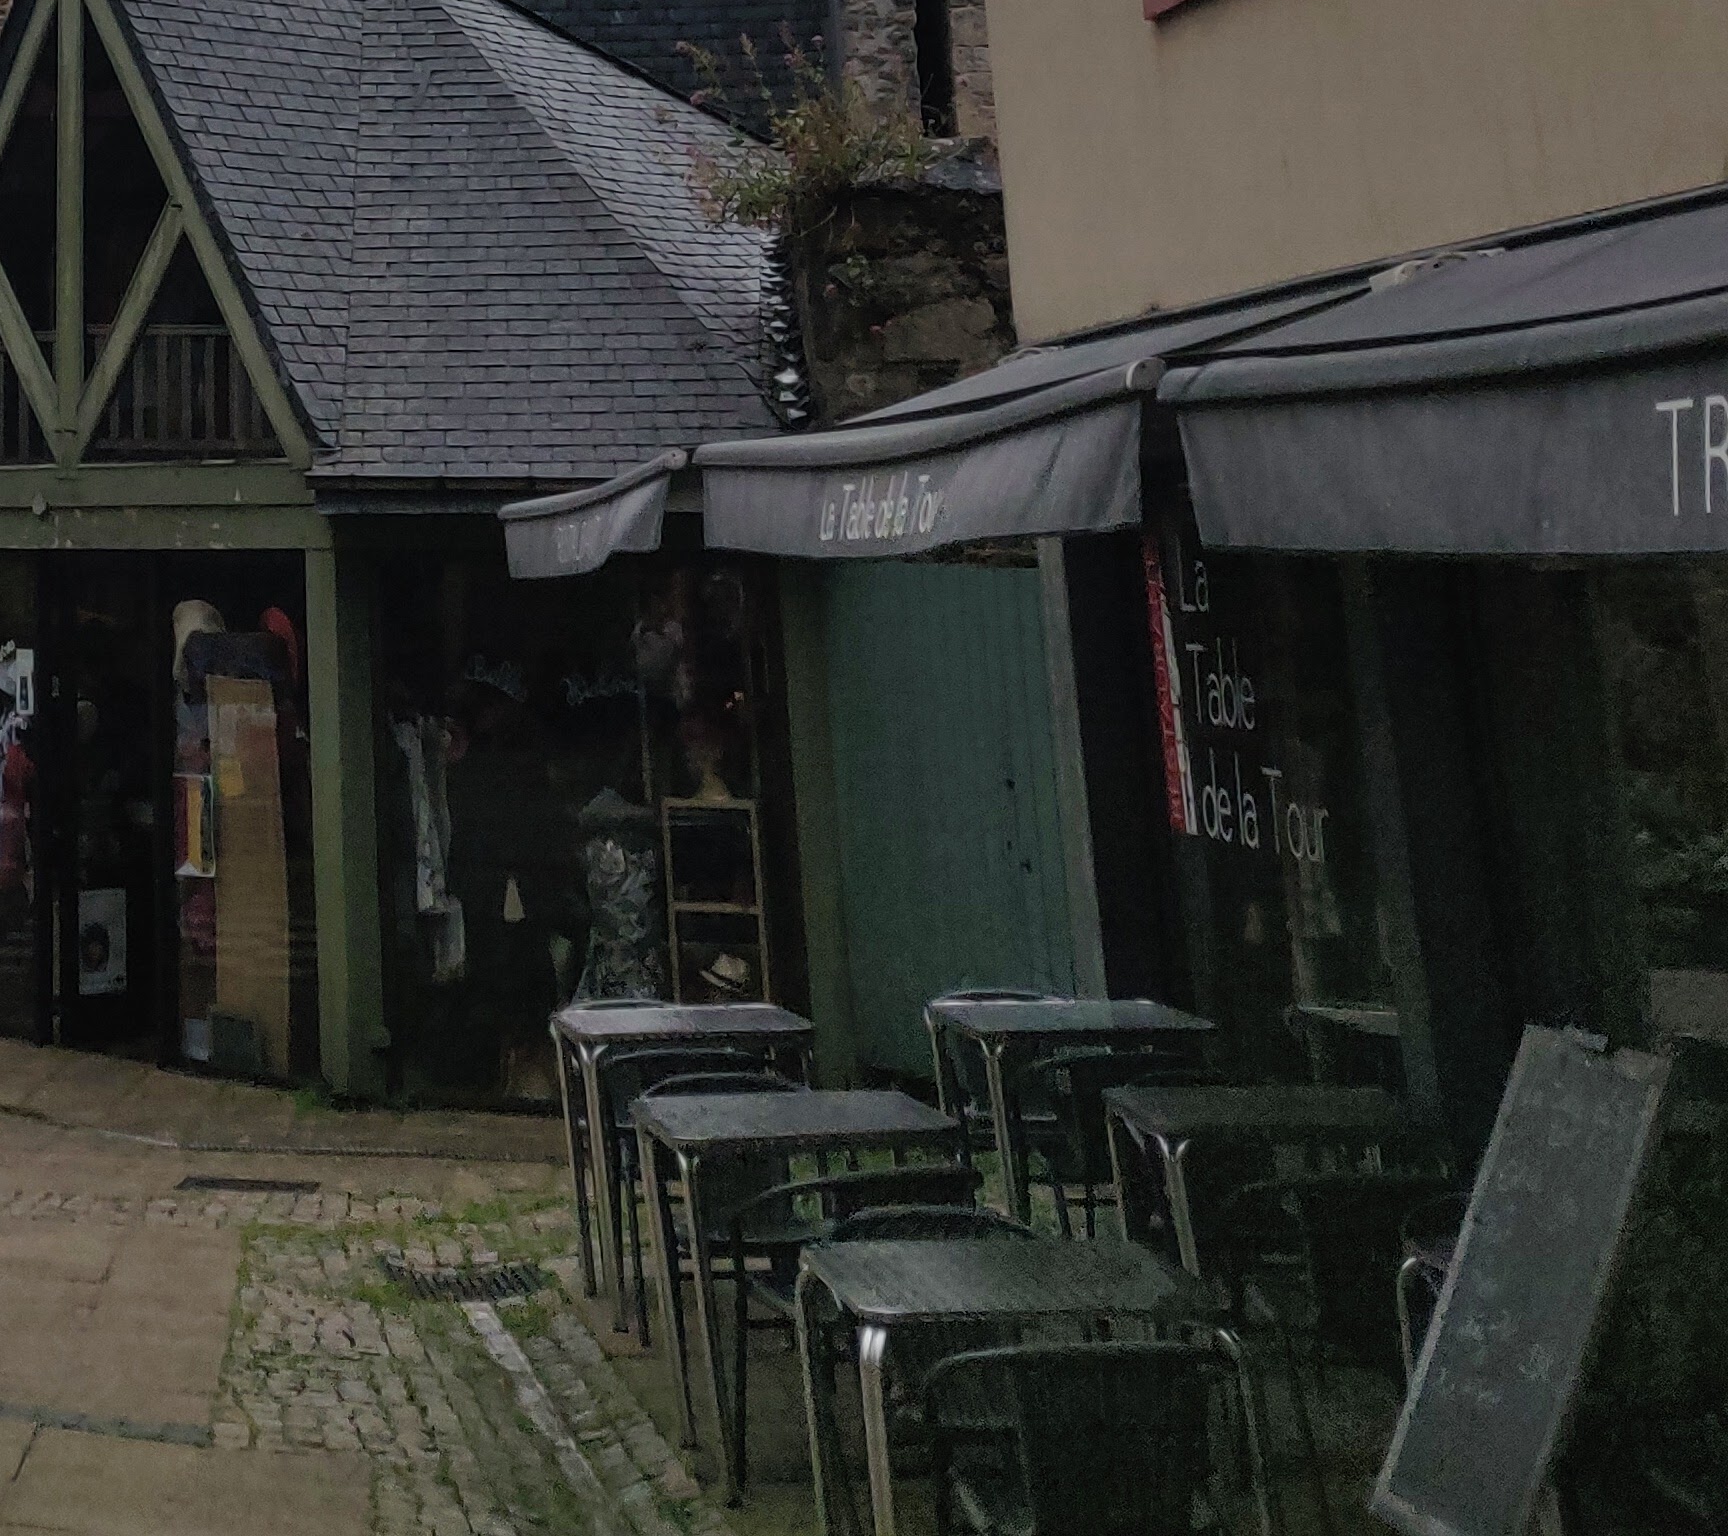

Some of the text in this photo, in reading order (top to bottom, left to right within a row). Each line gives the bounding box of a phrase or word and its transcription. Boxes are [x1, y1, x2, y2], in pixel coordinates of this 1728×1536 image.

[1174, 534, 1210, 613] La
[1185, 636, 1256, 731] Table
[1201, 748, 1330, 863] de la Tour
